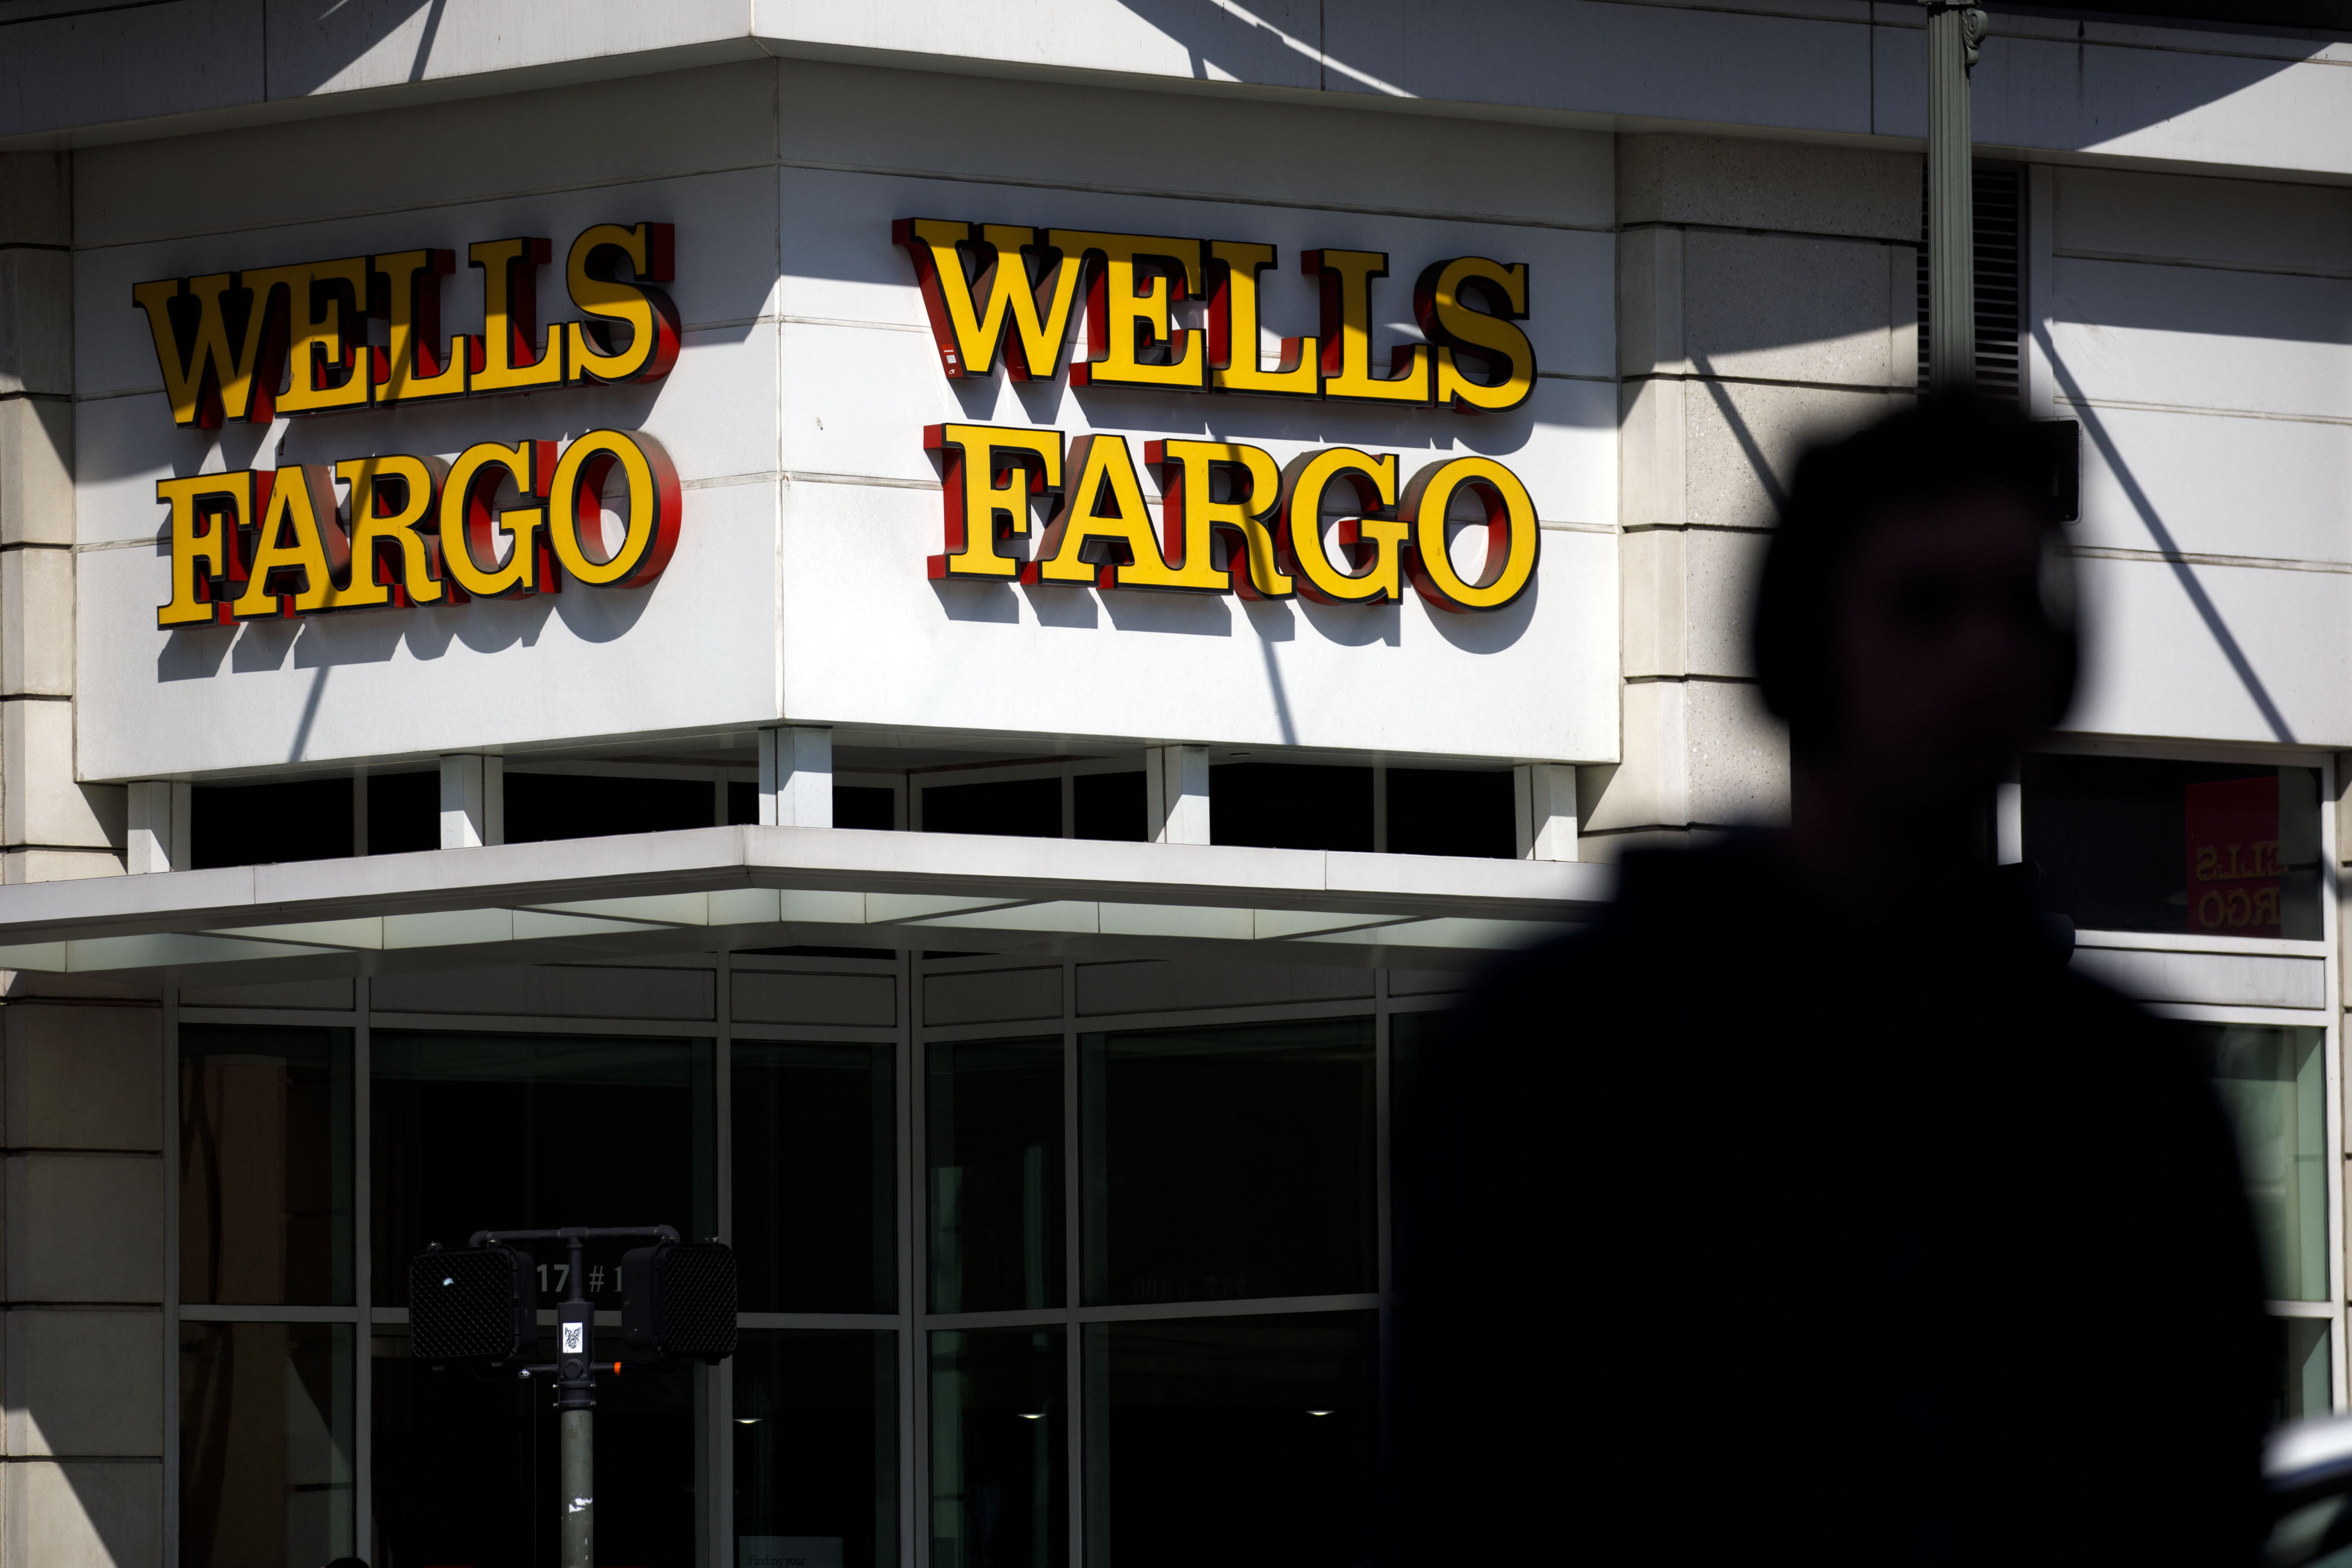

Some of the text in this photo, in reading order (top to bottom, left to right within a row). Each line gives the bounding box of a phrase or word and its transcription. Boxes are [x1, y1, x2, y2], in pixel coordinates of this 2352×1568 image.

[132, 221, 675, 429] WELLS
[904, 218, 1537, 415] WELLS
[155, 428, 666, 631] FARGO
[935, 423, 1541, 613] FARGO
[536, 1263, 570, 1293] 17
[748, 1554, 806, 1568] Finding your
